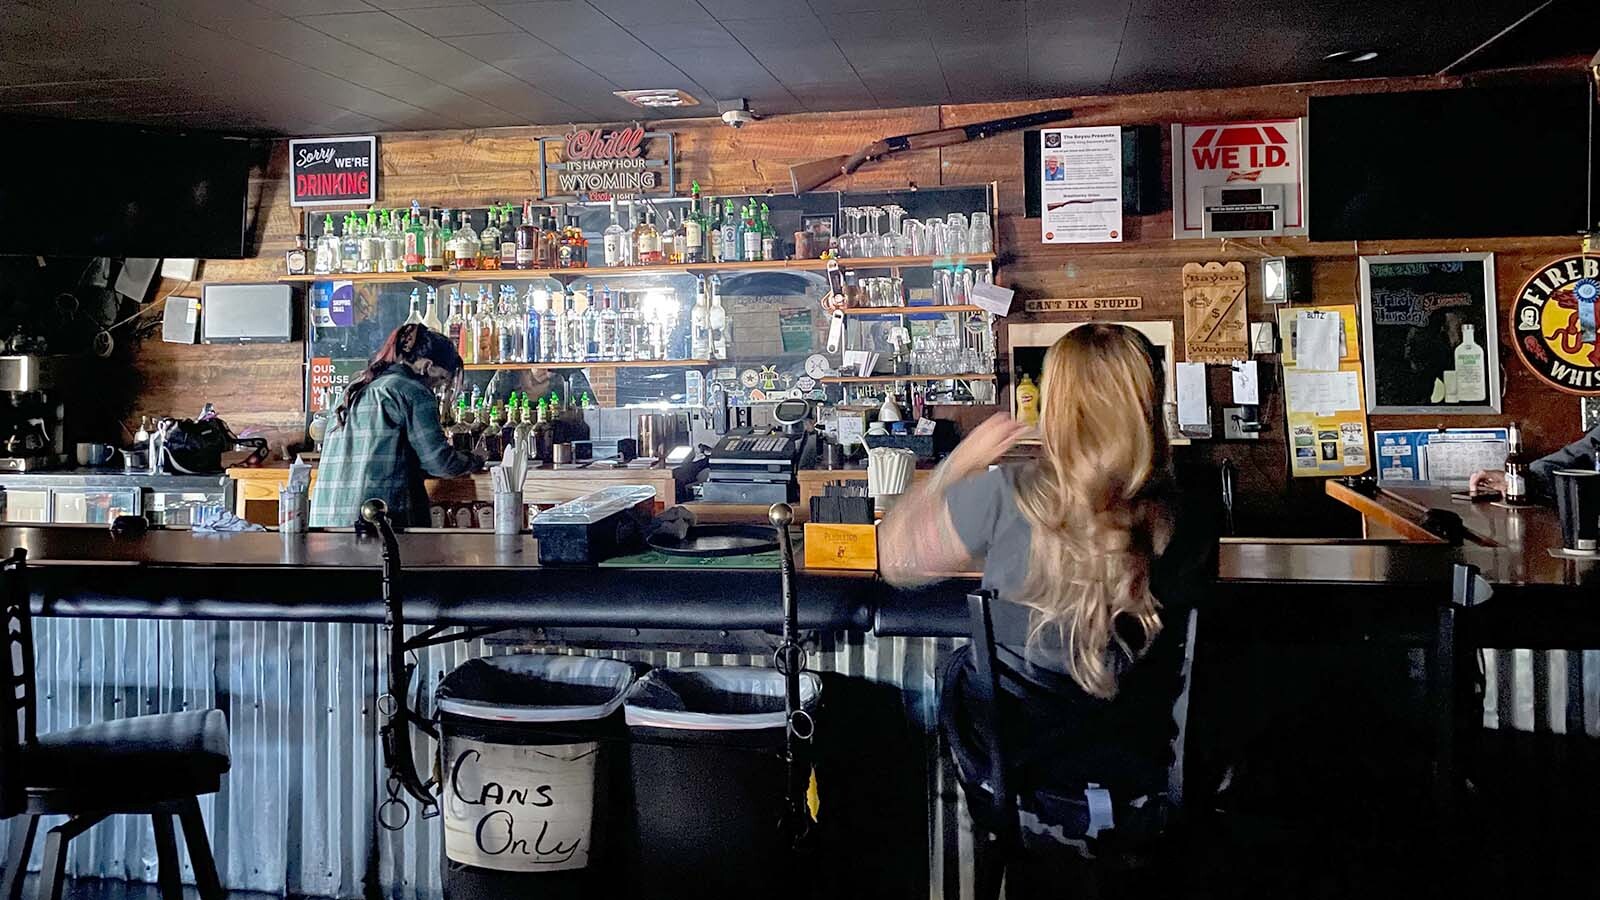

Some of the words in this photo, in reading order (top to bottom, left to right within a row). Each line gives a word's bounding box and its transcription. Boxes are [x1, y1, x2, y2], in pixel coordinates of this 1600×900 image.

[565, 127, 645, 160] Chill
[296, 147, 336, 168] Sorry
[334, 157, 369, 168] WE'RE
[1192, 147, 1240, 170] WE
[1250, 145, 1290, 168] I.D.
[566, 161, 582, 171] IT'S
[584, 160, 616, 170] HAPPY
[616, 159, 646, 169] HOUR
[296, 170, 369, 197] DRINKING
[559, 172, 655, 192] WYOMING
[1190, 274, 1240, 285] Bayou
[1028, 300, 1062, 310] CAN'T
[1067, 300, 1088, 309] FIX
[1094, 299, 1138, 309] STUPID
[313, 364, 336, 374] OUR
[313, 375, 349, 384] HOUSE
[312, 386, 342, 394] WNE
